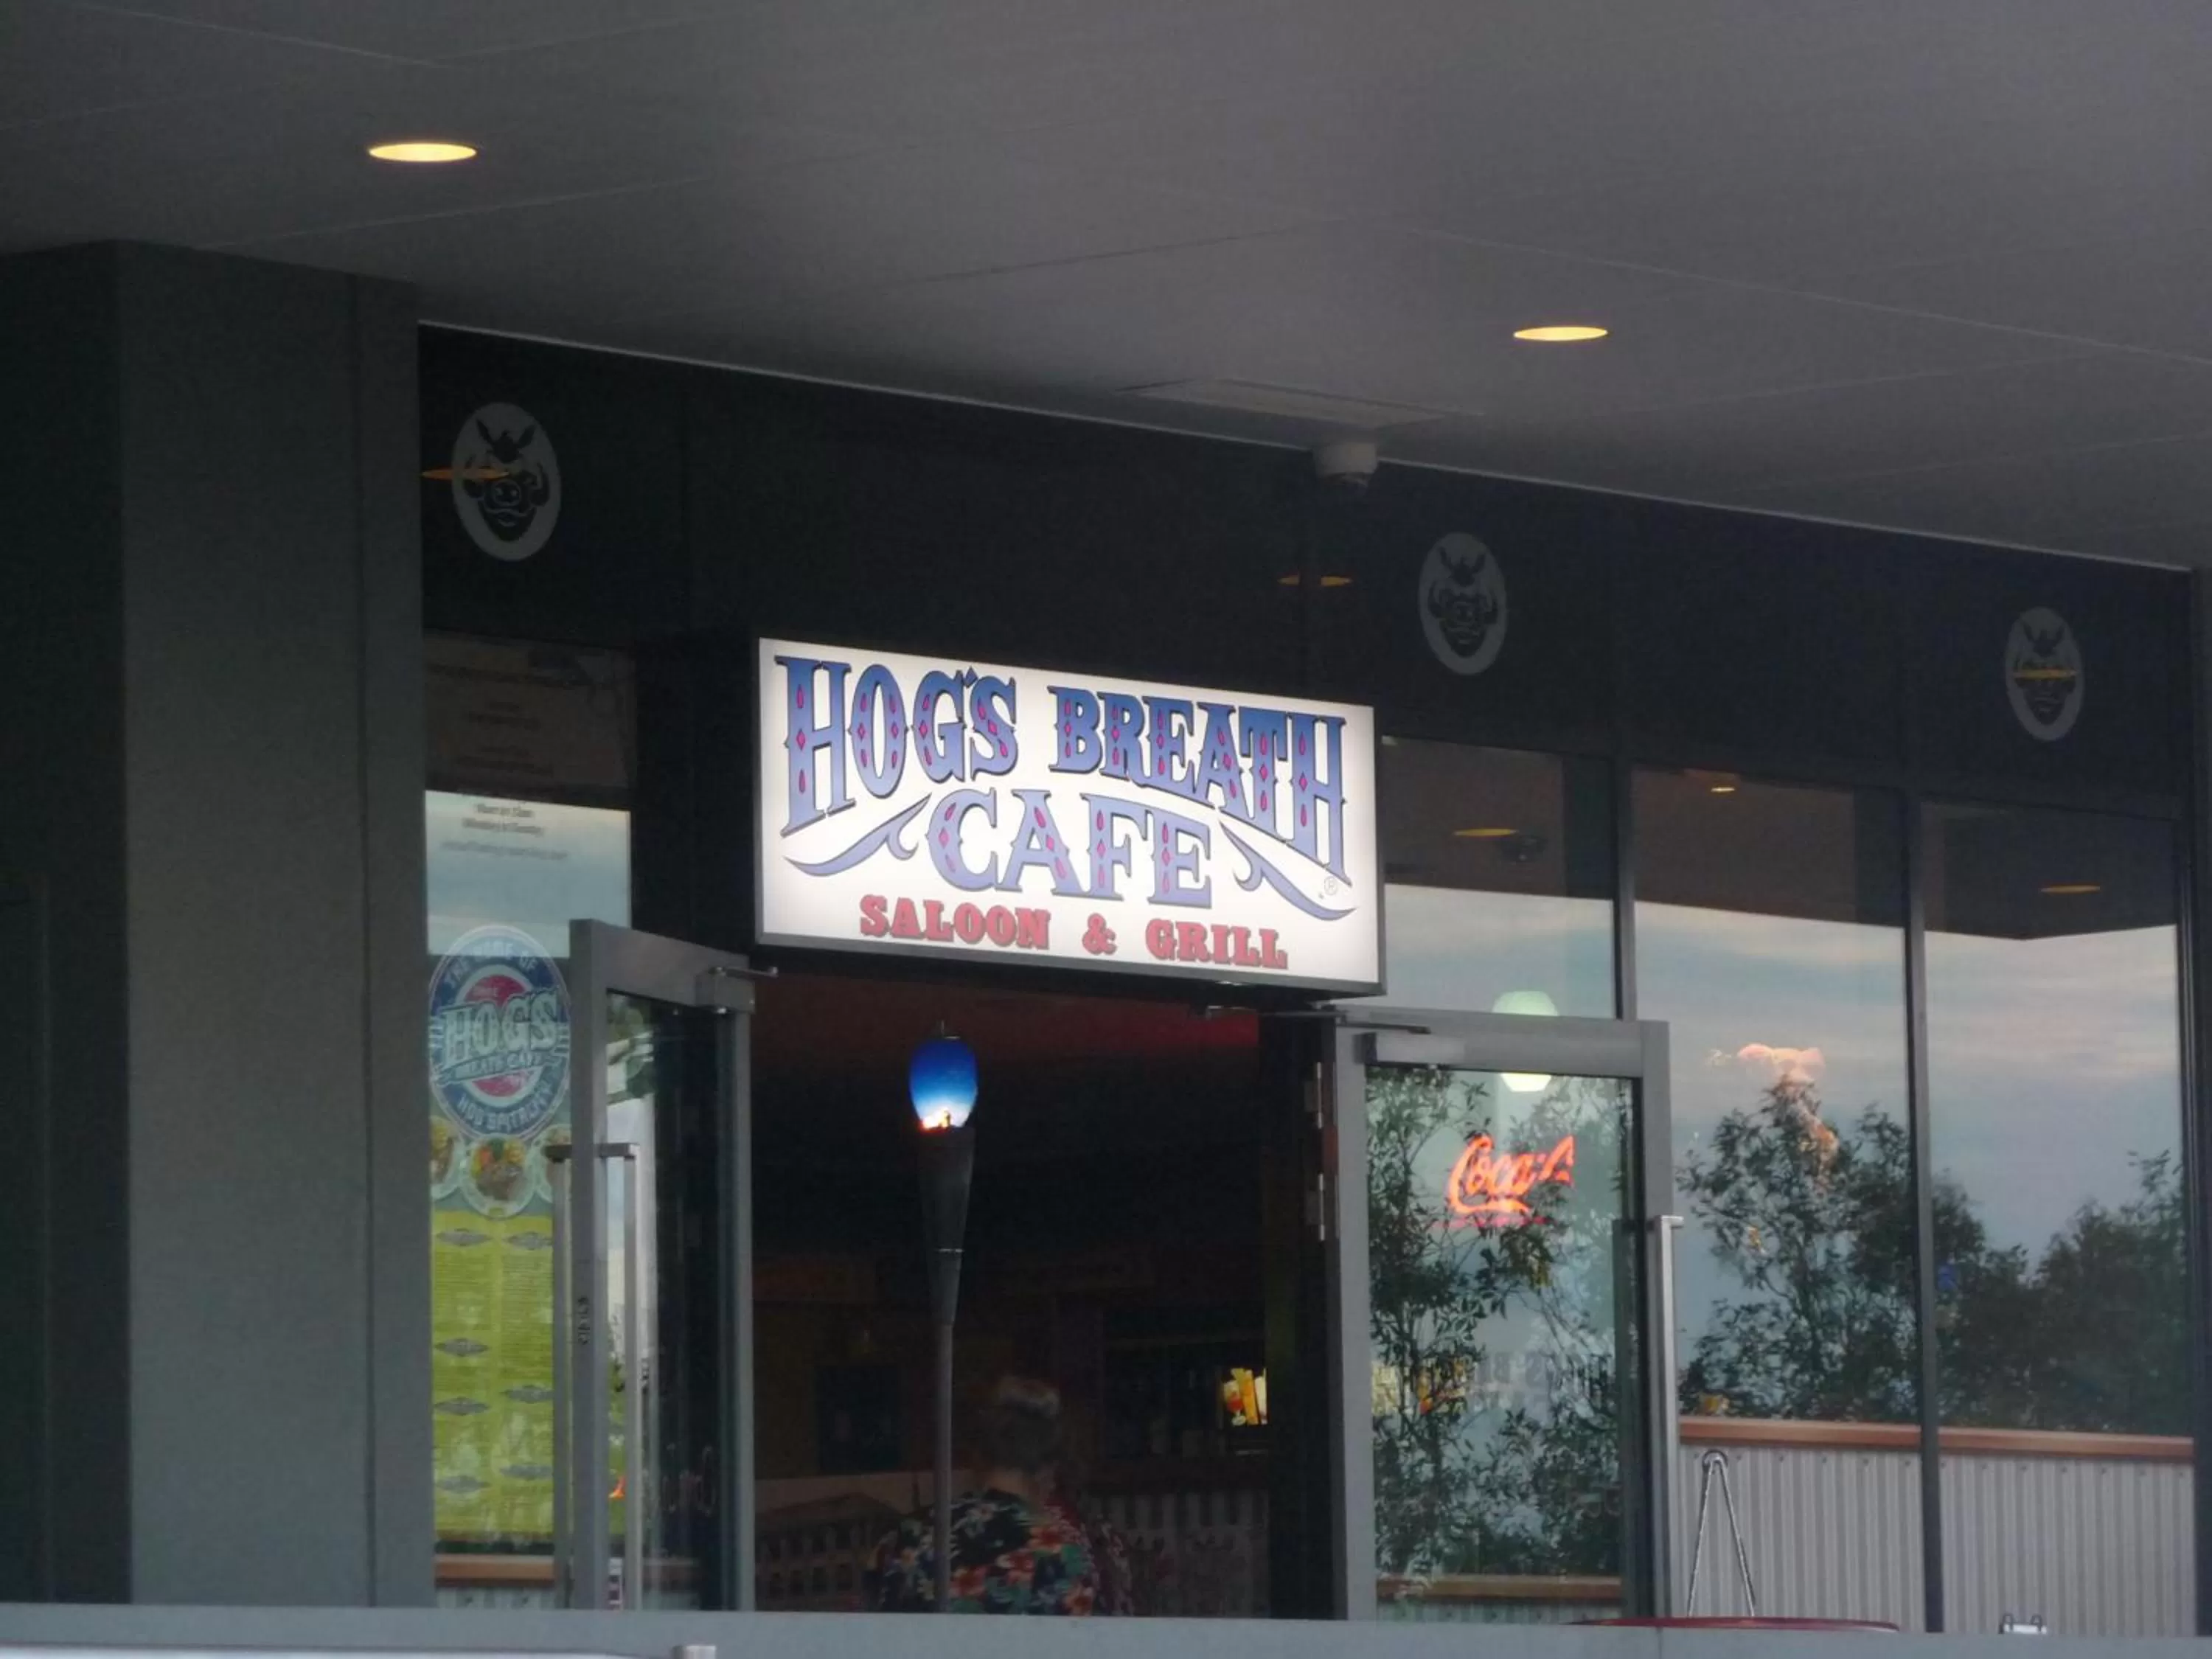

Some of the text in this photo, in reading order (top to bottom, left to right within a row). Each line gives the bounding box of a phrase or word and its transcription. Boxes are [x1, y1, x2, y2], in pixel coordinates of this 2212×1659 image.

[1046, 684, 1353, 889] BREATH
[926, 787, 1212, 909] CAFE
[860, 894, 1288, 971] SALOON & GRILL
